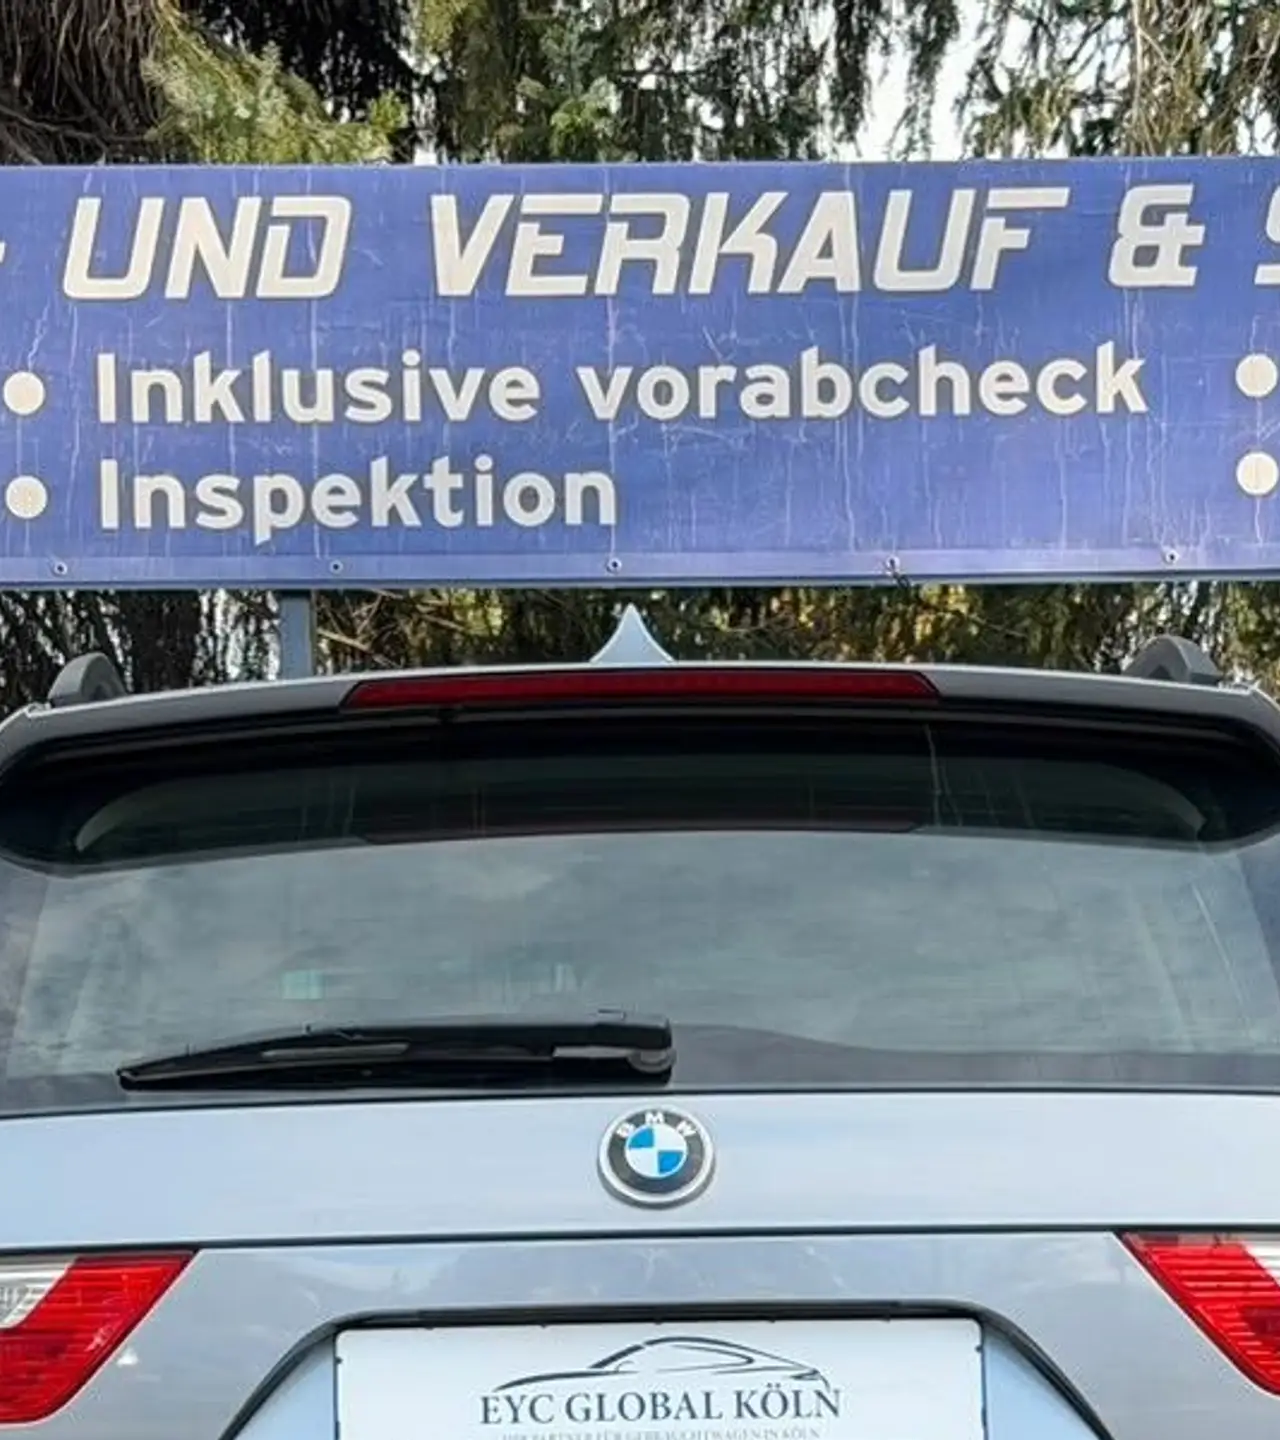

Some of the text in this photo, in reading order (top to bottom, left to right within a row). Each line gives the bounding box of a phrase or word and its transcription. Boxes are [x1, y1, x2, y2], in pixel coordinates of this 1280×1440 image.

[63, 195, 351, 299] UND
[431, 187, 1069, 296] VERKAUF
[1108, 184, 1206, 288] &
[97, 340, 1149, 424] Inklusive vorabcheck
[100, 455, 616, 545] Inspektion
[616, 1109, 697, 1138] BMW
[480, 1382, 841, 1425] EYC GLOBAL KÖLN
